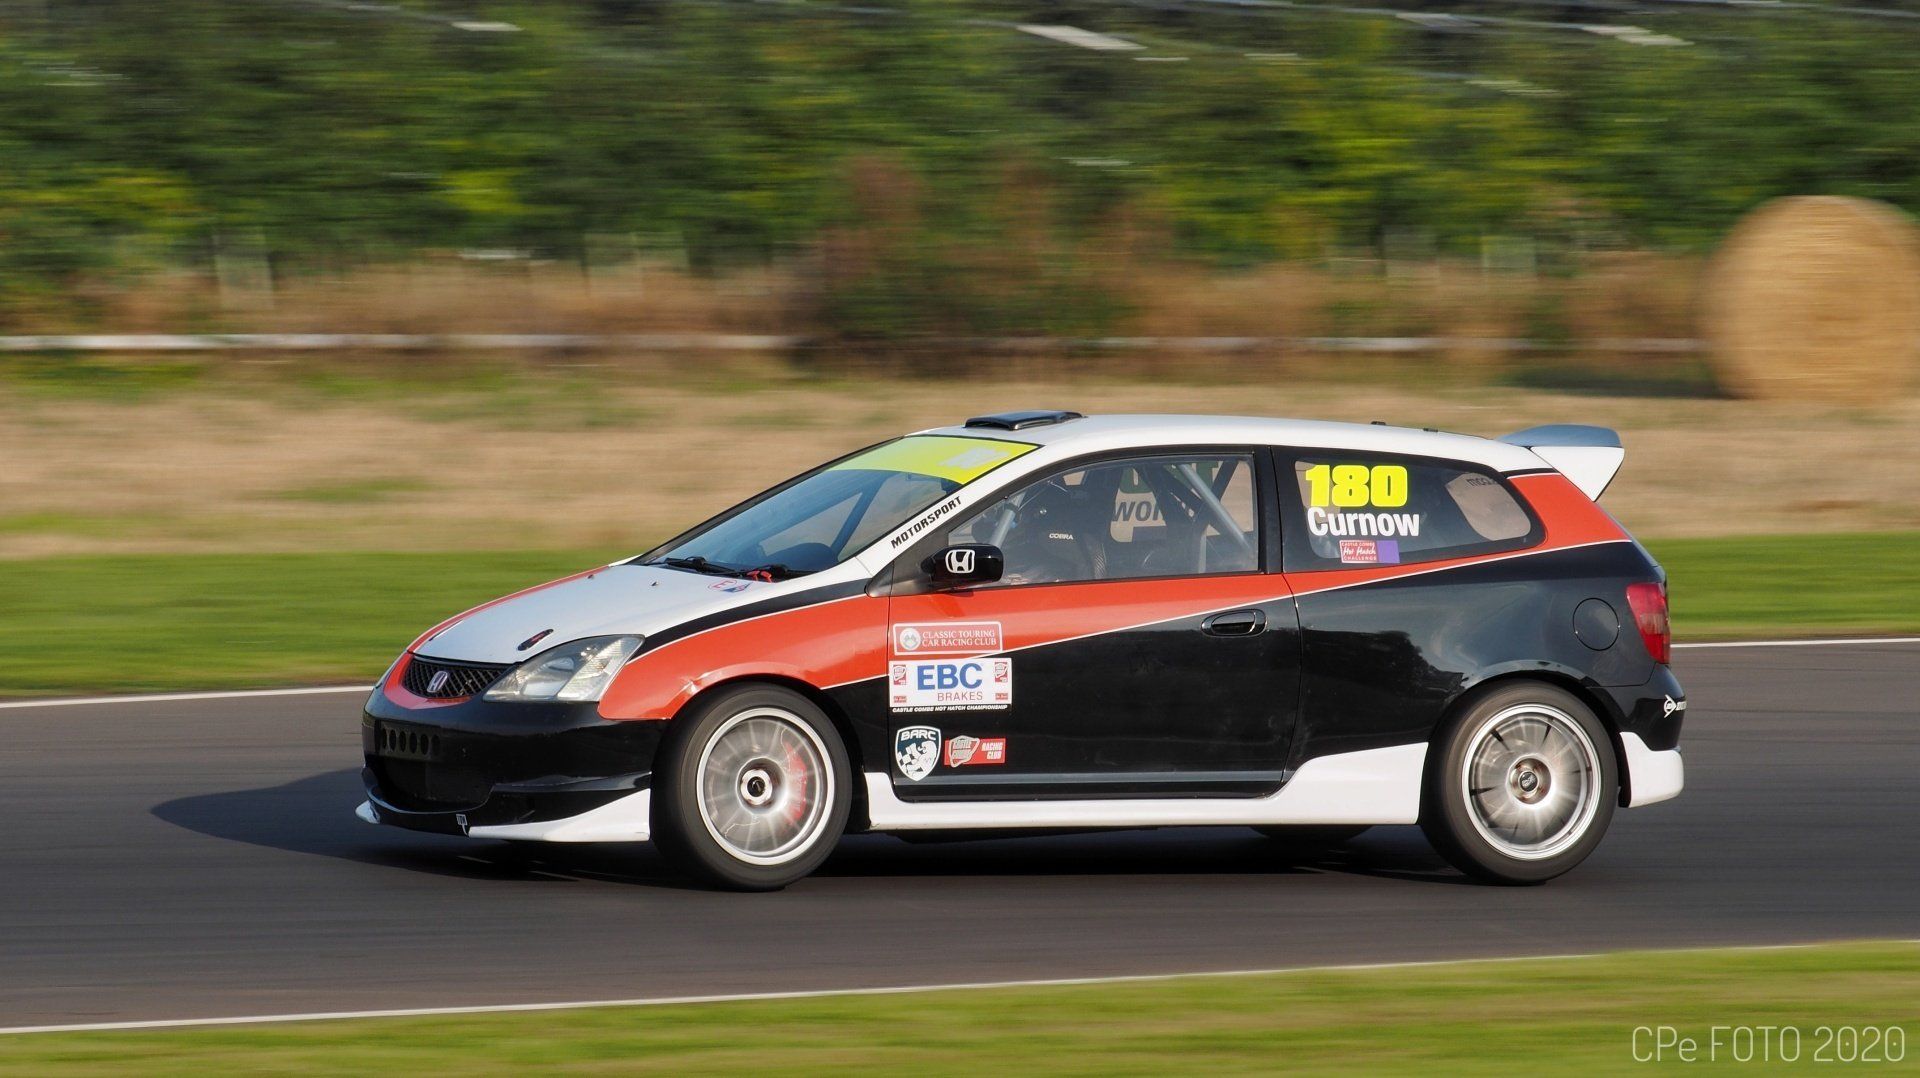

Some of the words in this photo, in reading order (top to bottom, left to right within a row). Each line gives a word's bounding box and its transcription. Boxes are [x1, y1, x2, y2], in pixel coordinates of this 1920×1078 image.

[1305, 464, 1408, 508] 180
[890, 495, 962, 549] MOTORSPORT
[1307, 507, 1420, 537] Curnow
[1049, 532, 1074, 541] COBRA
[922, 631, 957, 639] CLASSIC
[958, 629, 995, 638] TOURING
[921, 639, 940, 647] CAR
[941, 638, 973, 646] RACING
[974, 637, 997, 646] CLUB
[917, 663, 983, 691] EBC
[937, 691, 983, 702] BRAKES
[900, 729, 937, 741] BARC
[981, 742, 1004, 752] RACING
